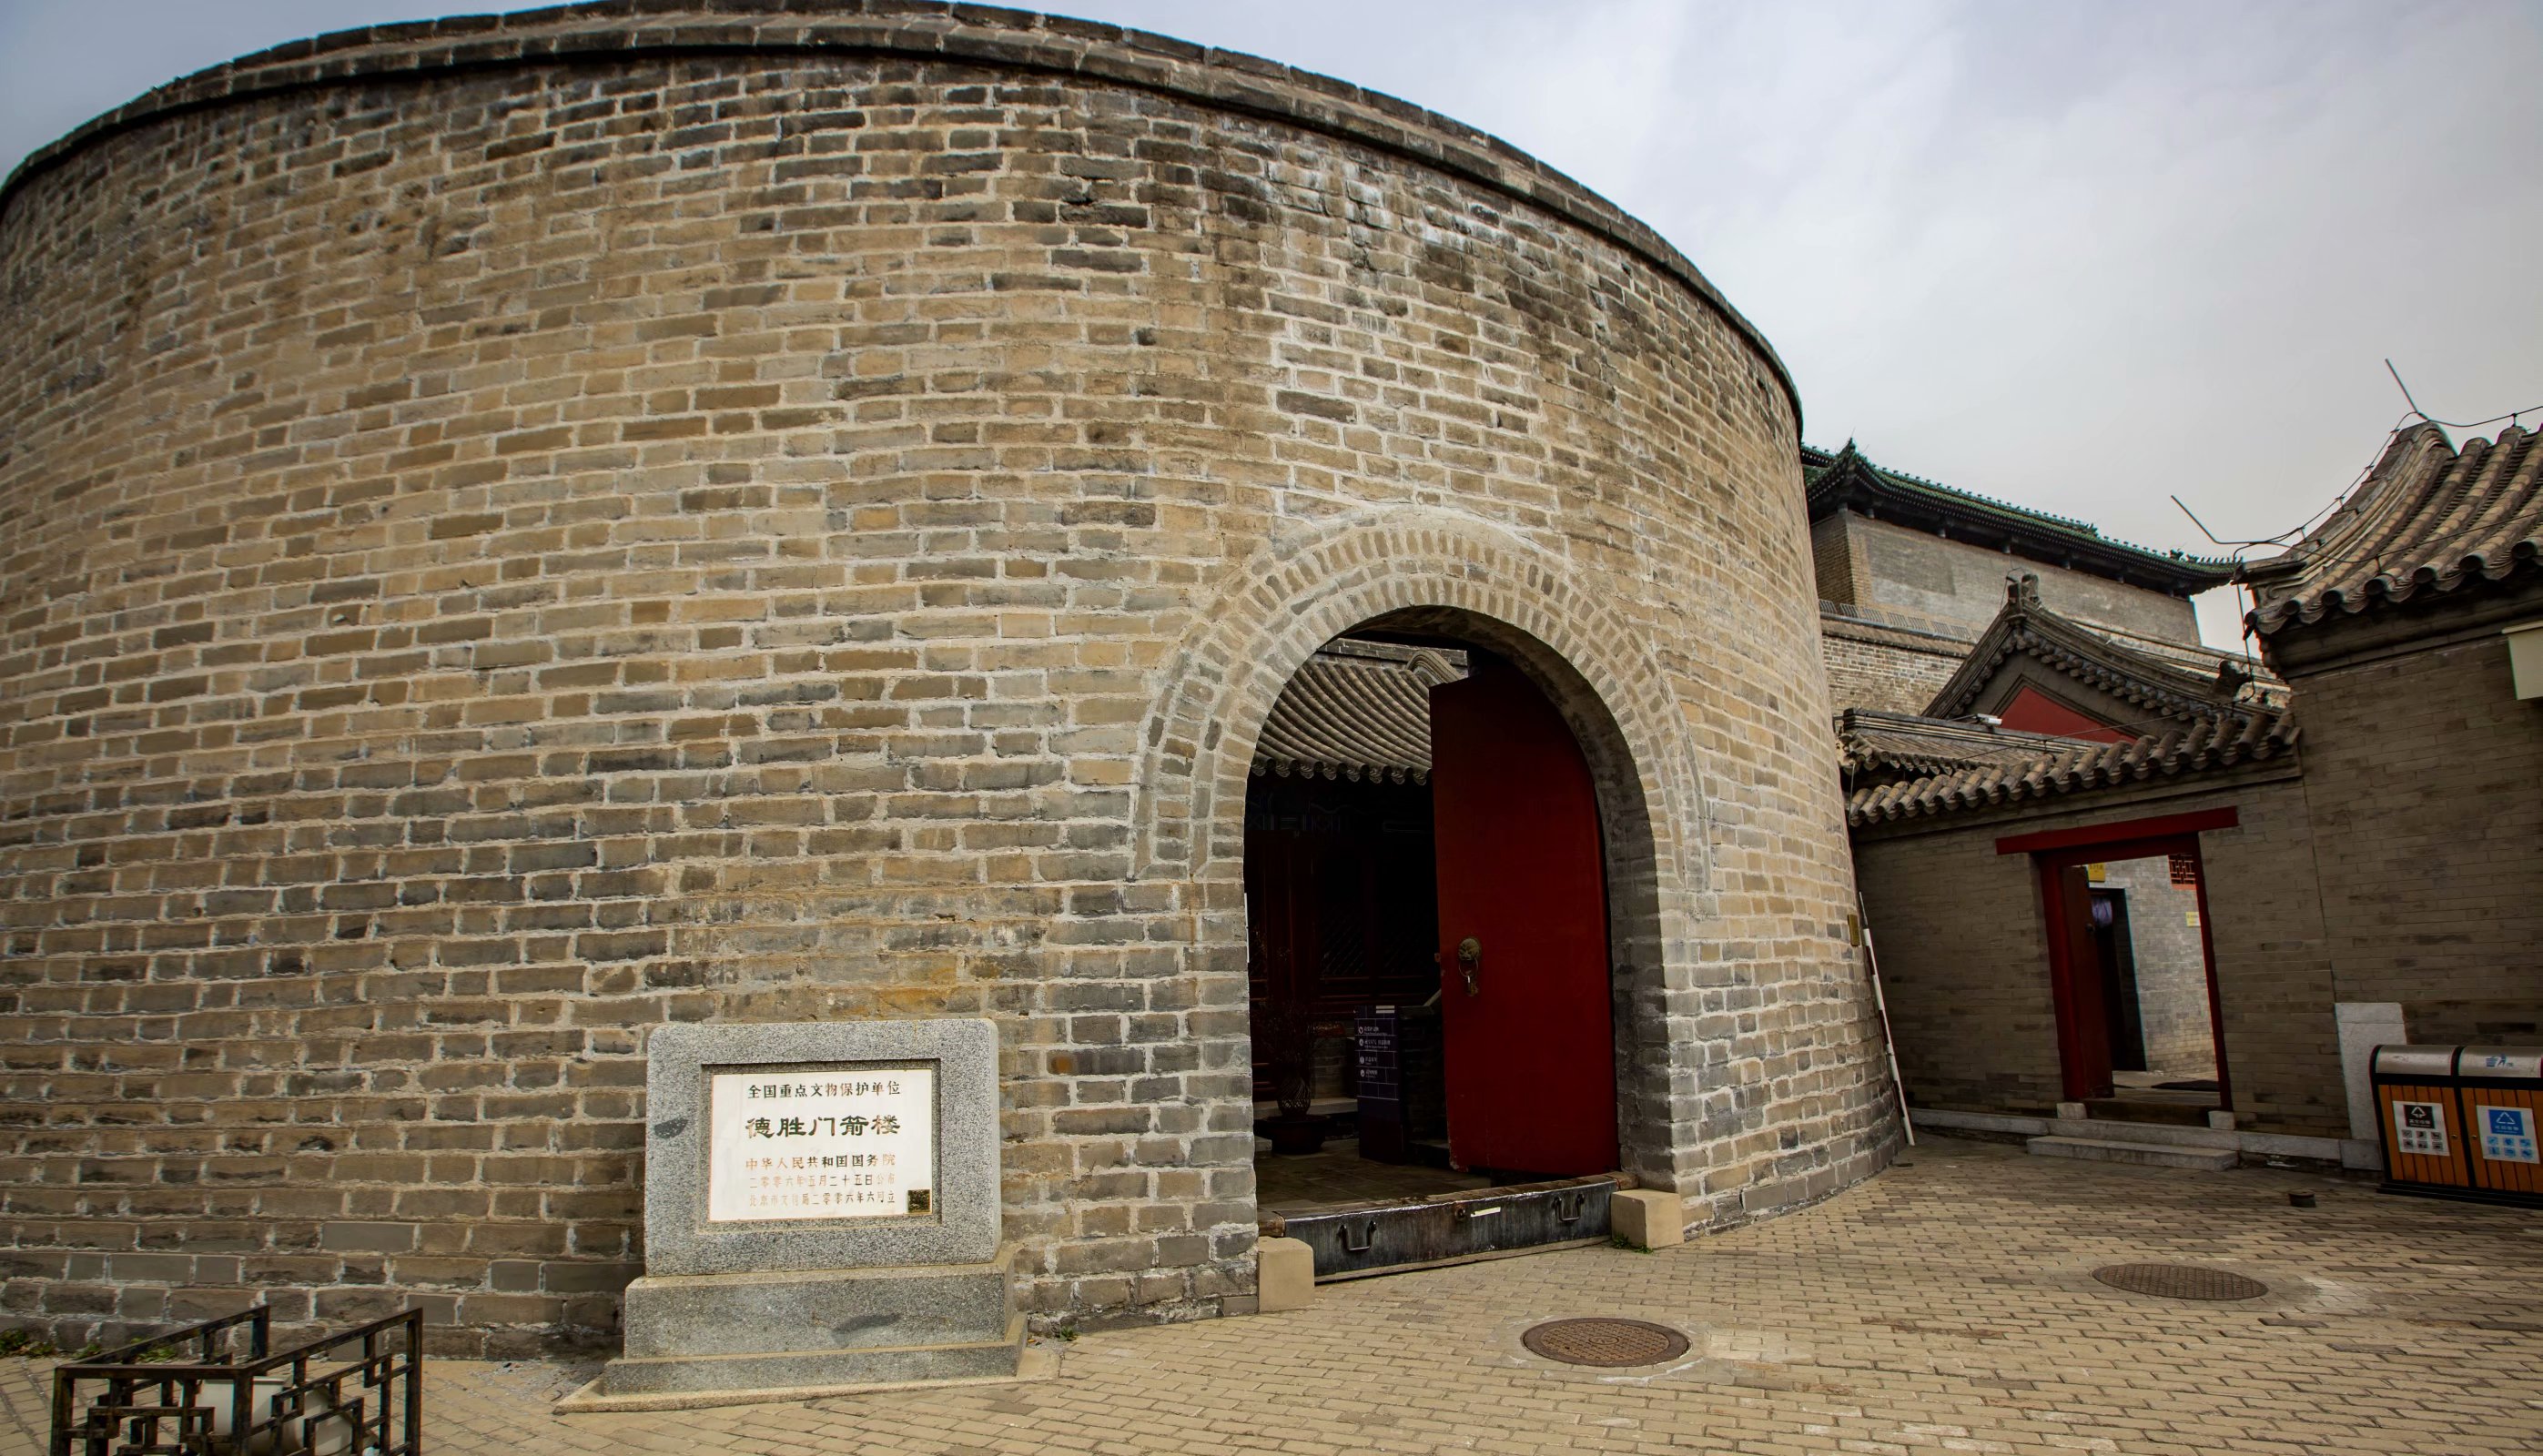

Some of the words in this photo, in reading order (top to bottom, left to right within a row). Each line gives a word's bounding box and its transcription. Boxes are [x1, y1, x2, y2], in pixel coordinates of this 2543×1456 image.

[747, 1080, 901, 1099] 全国重点文物保护单位
[745, 1115, 901, 1138] 德胜门箭楼
[745, 1154, 896, 1170] 中华人民共和国国务院
